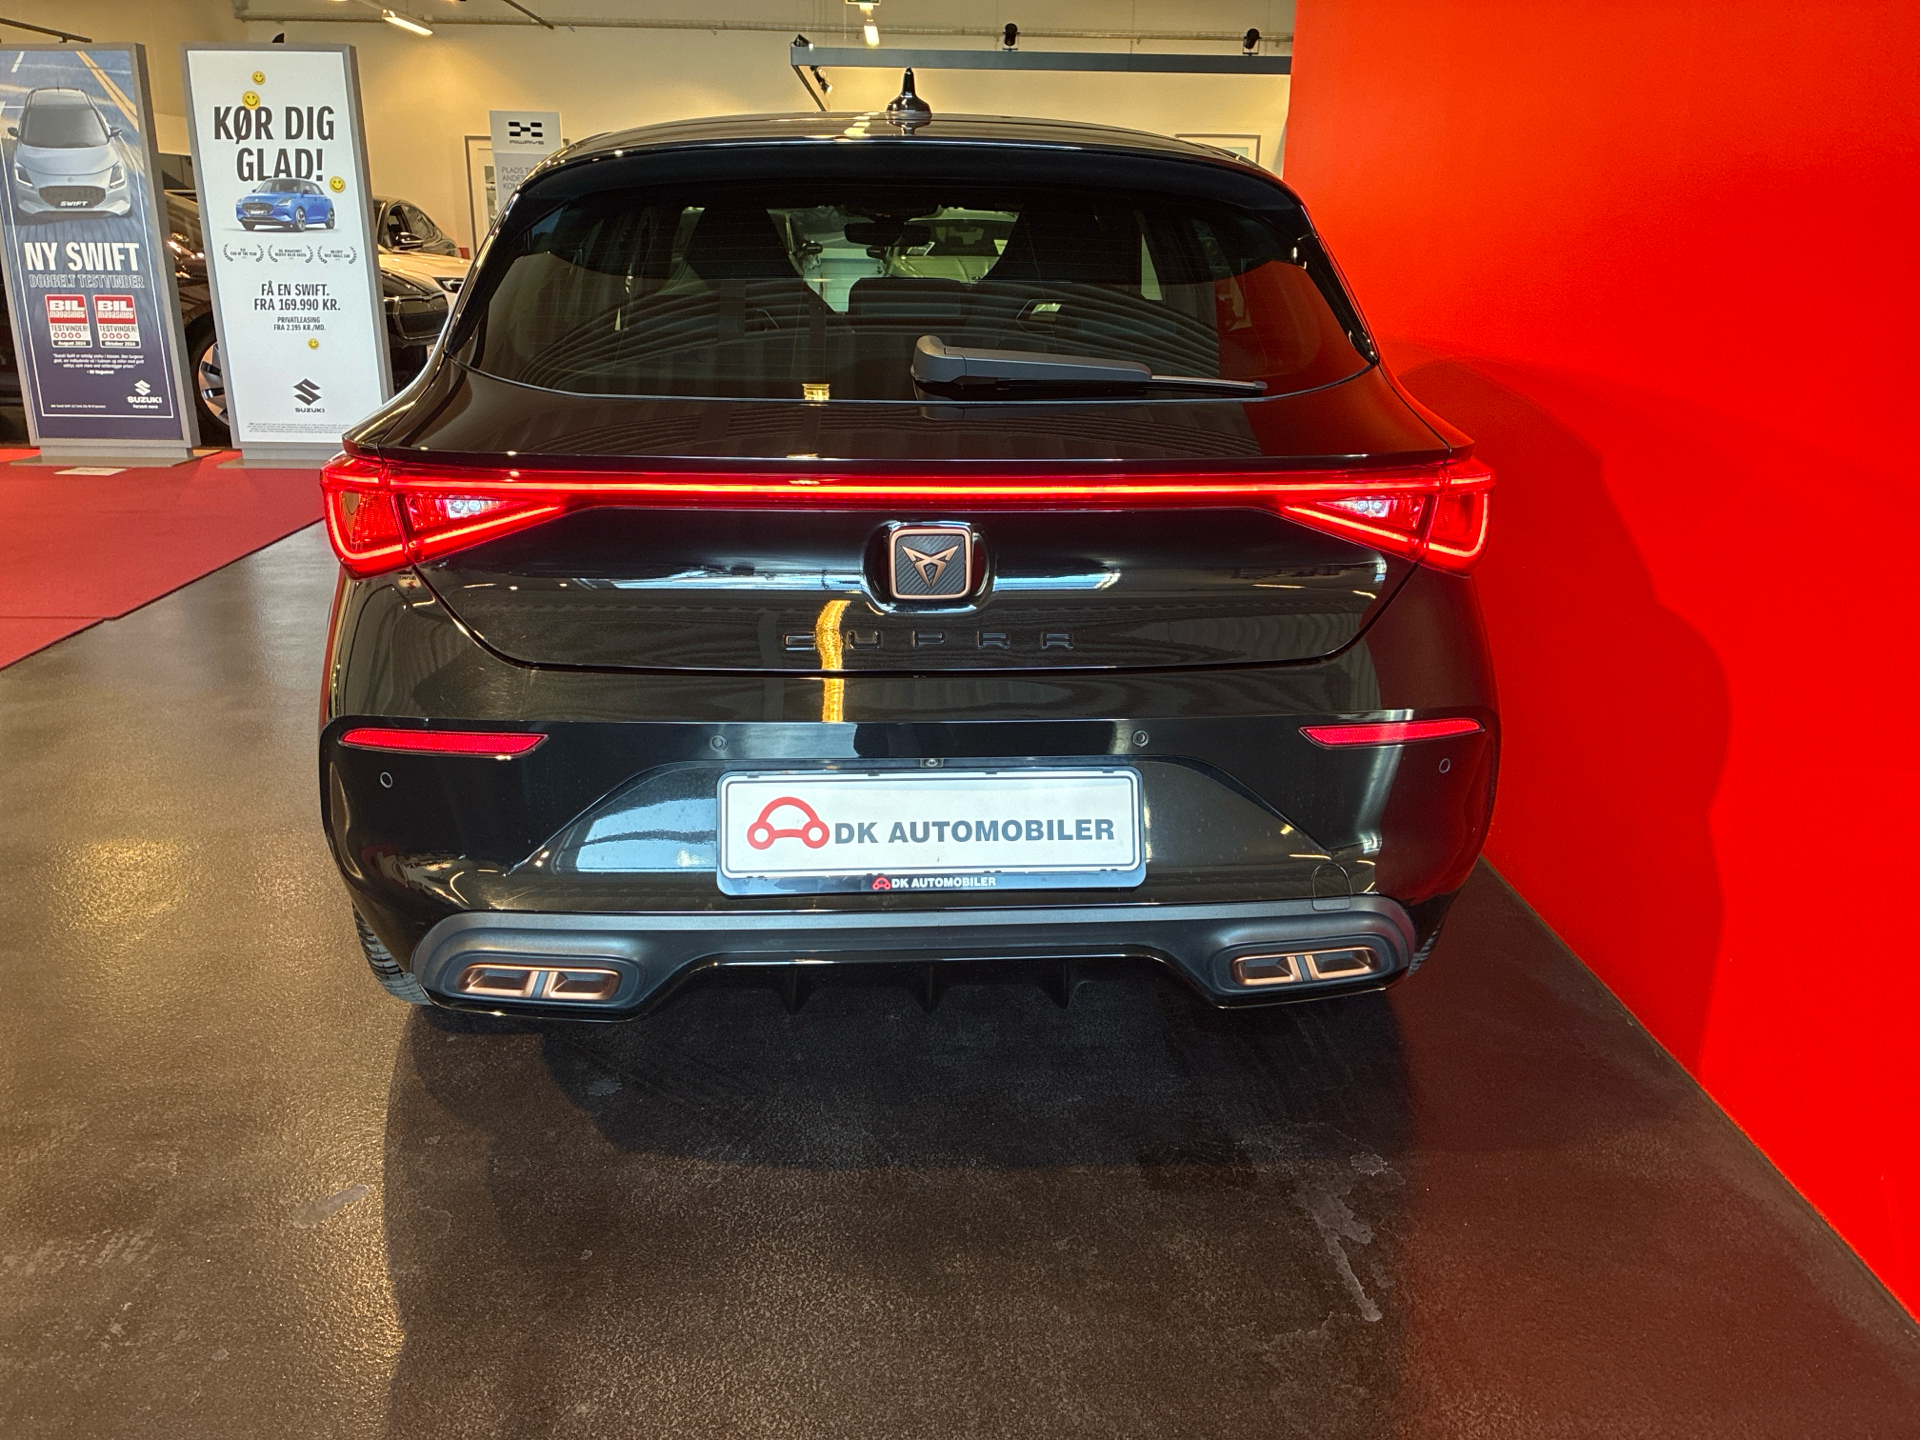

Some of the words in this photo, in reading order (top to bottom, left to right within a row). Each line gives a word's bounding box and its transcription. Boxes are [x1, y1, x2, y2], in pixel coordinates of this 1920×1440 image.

[214, 106, 274, 144] KØR
[285, 106, 334, 140] DIG
[236, 147, 323, 182] GLAD!
[24, 242, 58, 271] NY
[65, 241, 140, 272] SWIFT
[29, 274, 75, 289] DOBBELT
[77, 274, 145, 289] TESTVINDER
[261, 280, 274, 296] FÅ
[278, 283, 291, 296] EN
[295, 283, 330, 296] SWIFT.
[49, 300, 85, 311] BIL
[97, 300, 133, 312] BIL
[254, 298, 275, 311] FRA
[279, 298, 319, 311] 169.990
[322, 298, 341, 311] KR.
[277, 316, 321, 324] PRIVATLEASING
[127, 396, 163, 404] SUZUKI
[783, 629, 1075, 652] CUPRA
[835, 821, 879, 845] DK
[887, 818, 1115, 844] AUTOMOBILER
[892, 878, 909, 888] DK
[911, 876, 997, 888] AUTOMOBILER
